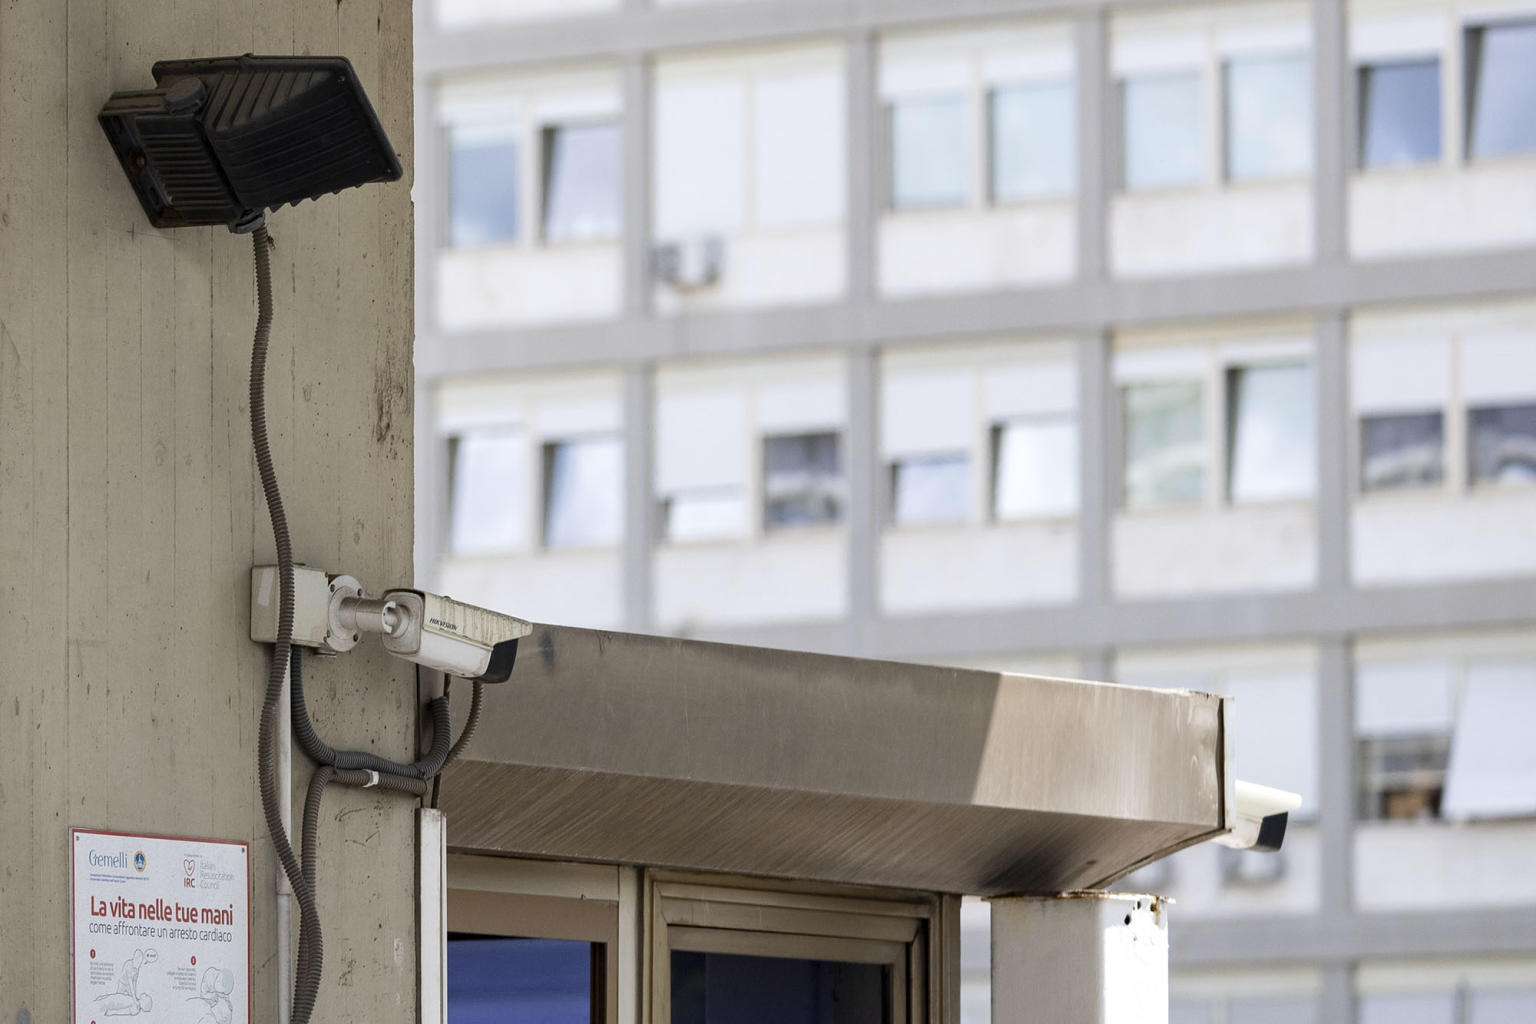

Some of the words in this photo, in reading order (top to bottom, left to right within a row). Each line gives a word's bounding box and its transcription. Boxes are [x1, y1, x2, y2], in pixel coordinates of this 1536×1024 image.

[429, 617, 457, 631] HIKVISION
[88, 849, 128, 868] Gemelli
[183, 877, 195, 888] IRC
[90, 895, 107, 917] La
[109, 895, 135, 919] vita
[138, 898, 172, 922] nelle
[175, 902, 198, 923] tue
[201, 904, 233, 925] mani
[88, 922, 112, 935] come
[113, 920, 156, 937] affrontare
[157, 927, 168, 938] un
[169, 927, 198, 941] arresto
[199, 928, 232, 943] cardiaco
